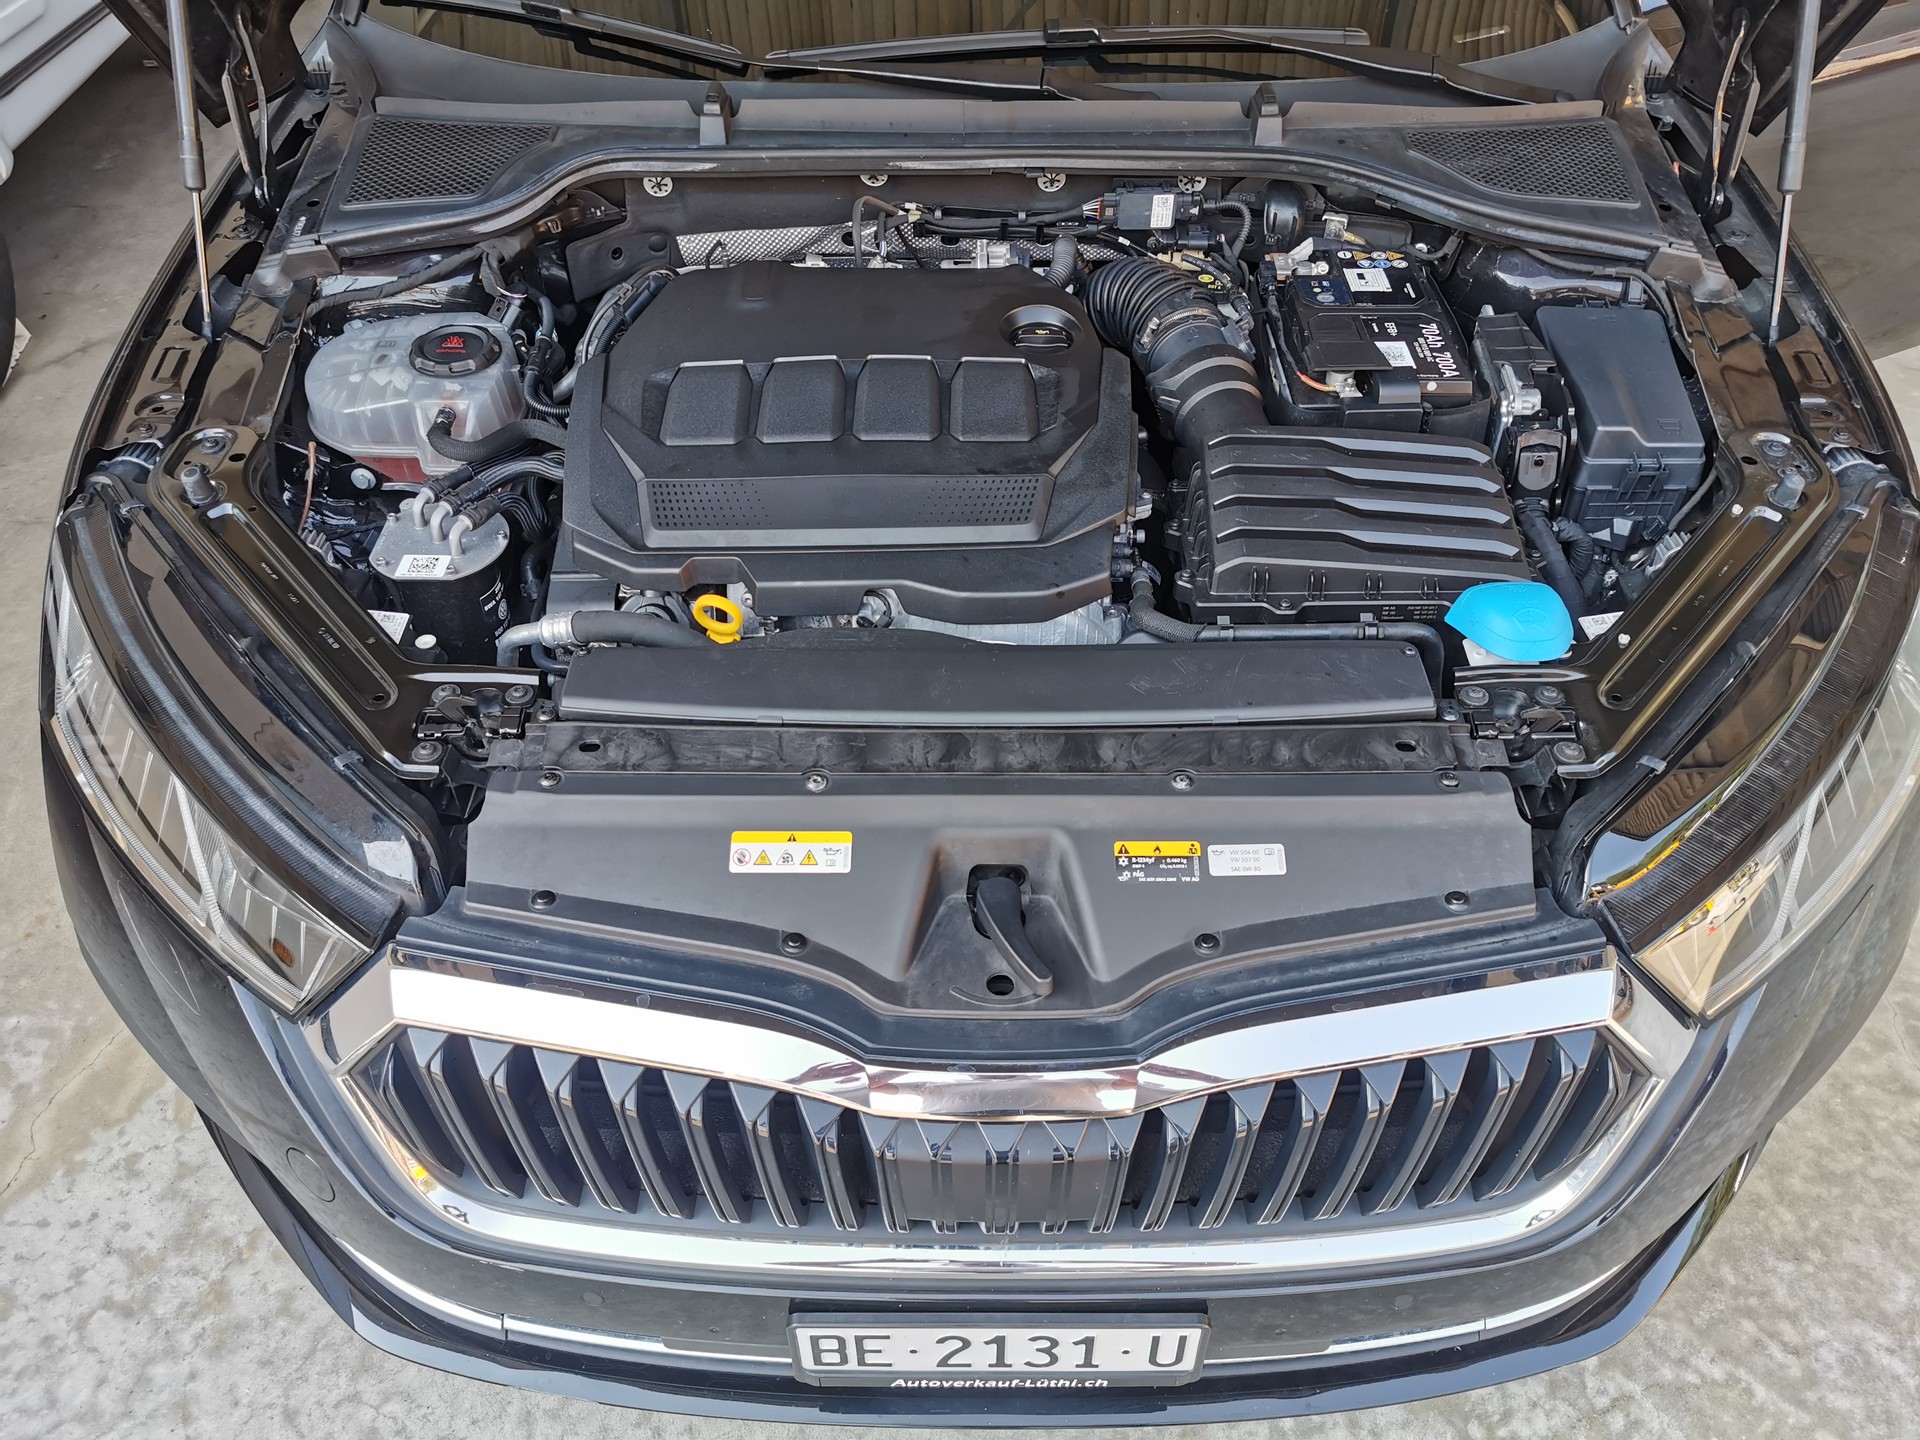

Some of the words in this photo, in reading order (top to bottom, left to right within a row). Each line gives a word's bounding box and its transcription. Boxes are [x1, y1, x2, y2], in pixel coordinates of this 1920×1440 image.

[1419, 323, 1445, 348] 70Ah
[1432, 351, 1460, 378] 700A
[809, 1334, 893, 1367] BE
[935, 1334, 1100, 1369] 2131
[1148, 1335, 1190, 1368] U
[890, 1377, 1109, 1389] Autoverkauf-Lüthi.ch
